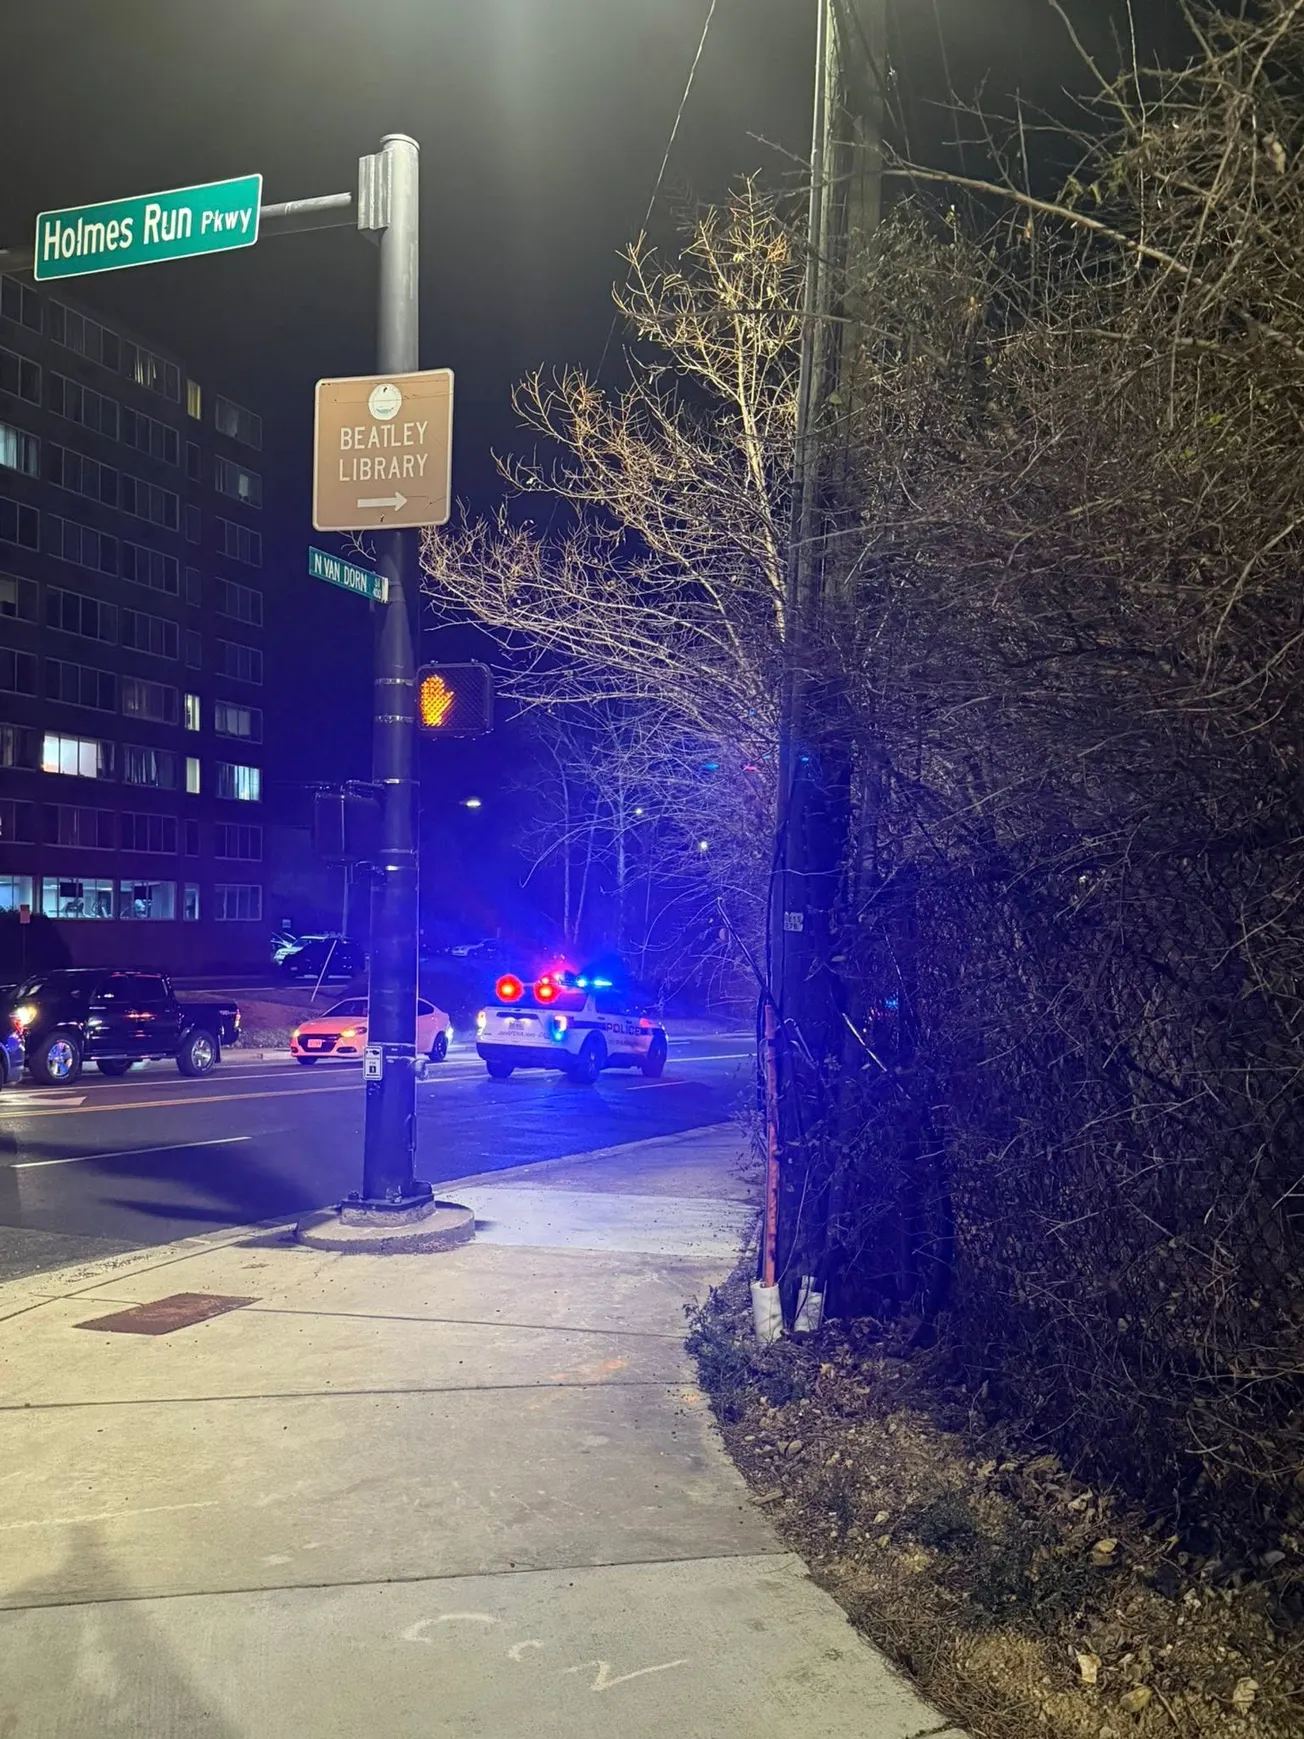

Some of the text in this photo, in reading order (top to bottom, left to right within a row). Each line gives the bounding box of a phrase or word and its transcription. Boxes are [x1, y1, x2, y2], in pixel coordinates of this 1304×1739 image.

[43, 203, 252, 261] Holmes Run Pkwy
[340, 421, 428, 450] BEATLEY
[339, 453, 428, 481] LIBRARY
[314, 553, 322, 574] N
[323, 557, 340, 582] VAN
[343, 565, 367, 593] DORN
[606, 1022, 641, 1036] POLICE
